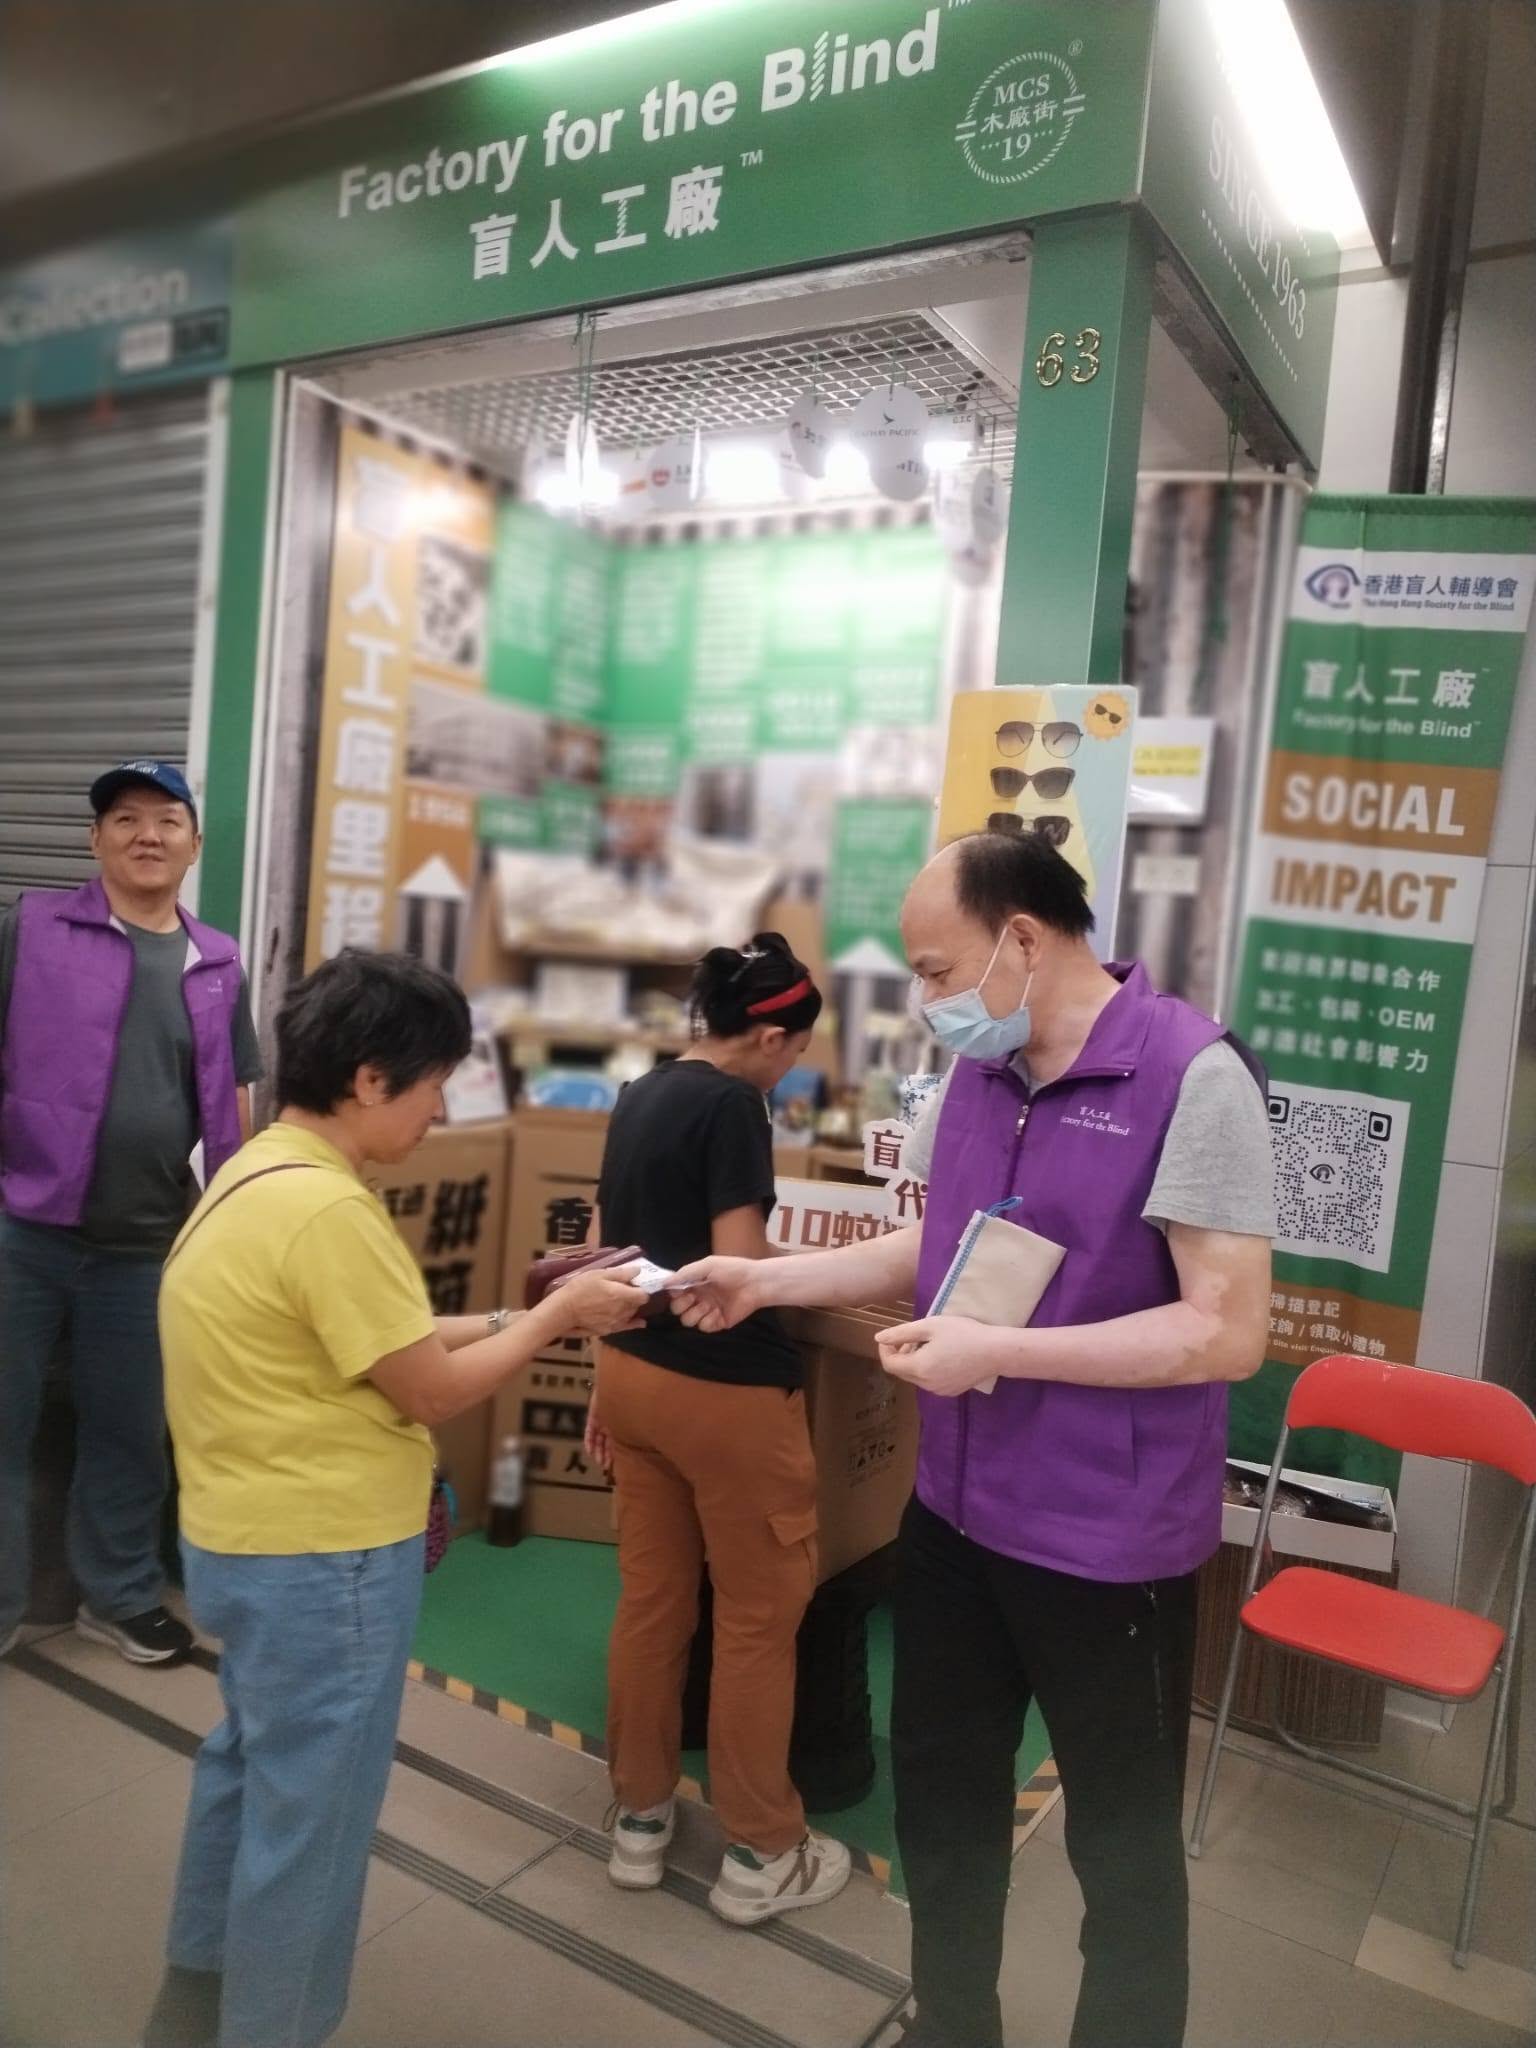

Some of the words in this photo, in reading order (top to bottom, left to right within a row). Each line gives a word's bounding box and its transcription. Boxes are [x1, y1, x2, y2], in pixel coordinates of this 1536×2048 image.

[992, 74, 1050, 107] MCS
[338, 134, 527, 218] Factory
[543, 109, 624, 167] for
[640, 79, 737, 142] the
[761, 8, 940, 112] Blind
[980, 100, 1058, 134] 木廠街
[1001, 133, 1032, 161] 19
[469, 163, 724, 280] 盲人工廠
[1209, 114, 1273, 278] SINCE
[1271, 240, 1306, 340] 1963
[1036, 327, 1100, 386] 63
[1364, 574, 1518, 598] 香港盲人輔導會
[1457, 602, 1472, 610] for
[1473, 602, 1488, 610] the
[1490, 602, 1514, 611] Blind
[1303, 660, 1477, 709] 盲人工廠
[1420, 719, 1473, 738] Blind
[1283, 775, 1465, 837] SOCIAL
[1271, 857, 1456, 924] IMPACT
[1378, 1006, 1436, 1032] OEM
[1083, 1118, 1095, 1129] for
[1107, 1124, 1129, 1136] Blind
[872, 1129, 904, 1170] 盲
